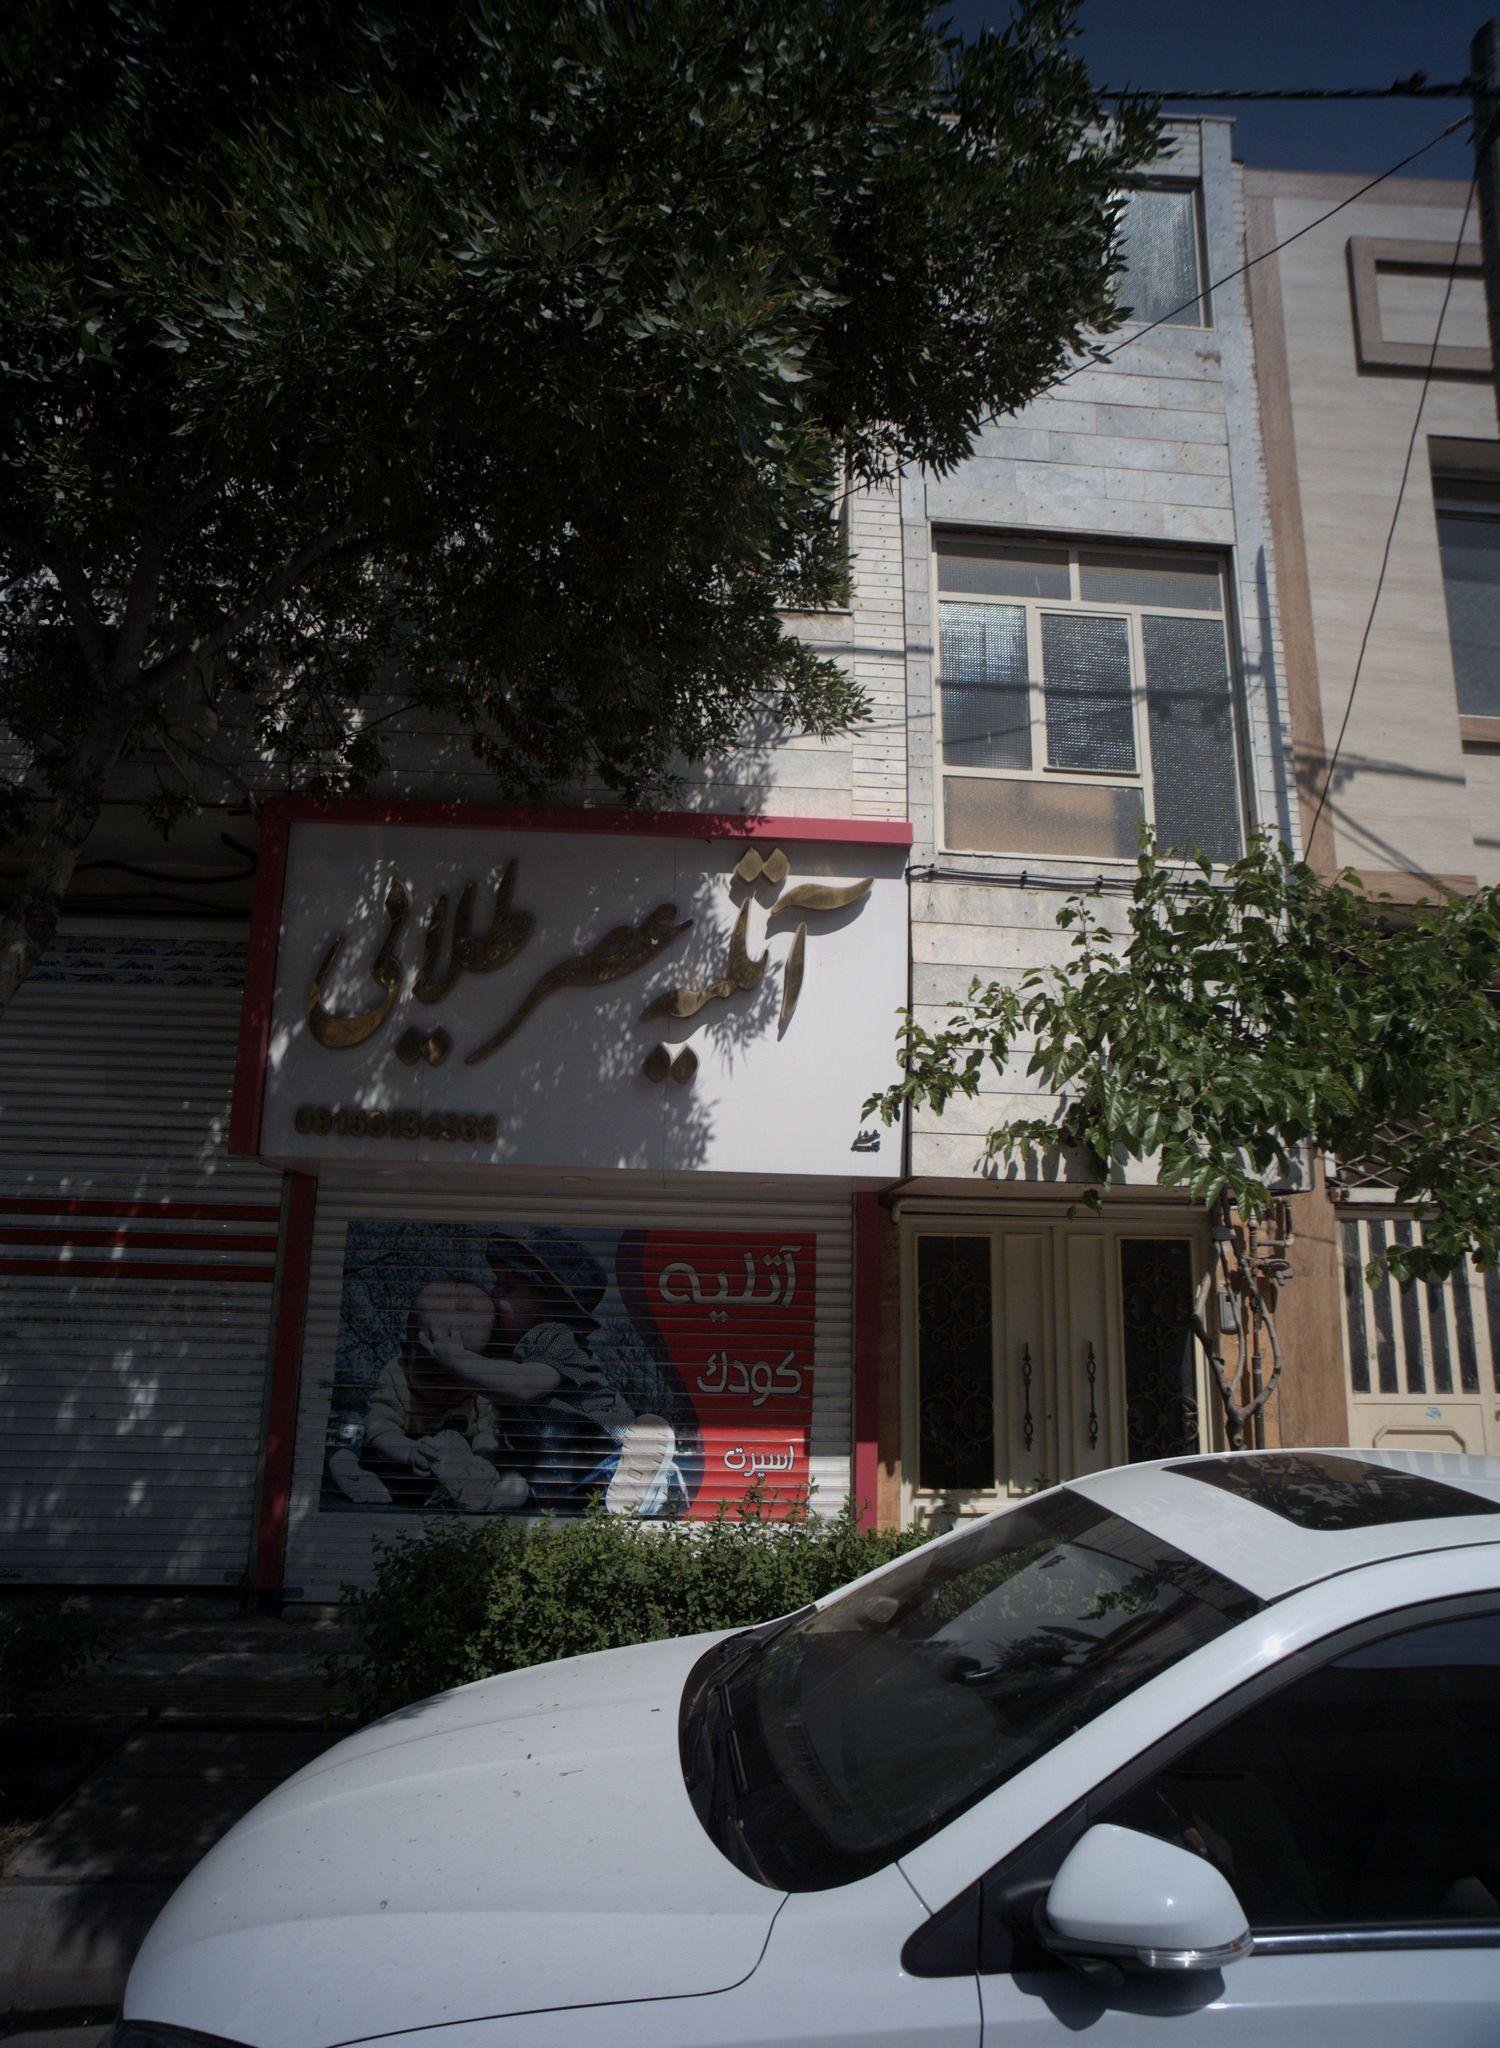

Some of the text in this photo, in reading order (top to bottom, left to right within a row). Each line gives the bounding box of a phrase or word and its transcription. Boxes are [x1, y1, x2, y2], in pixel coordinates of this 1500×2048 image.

[306, 846, 874, 1084] آتلیه عصر طلایی
[658, 1244, 803, 1322] آتلیه
